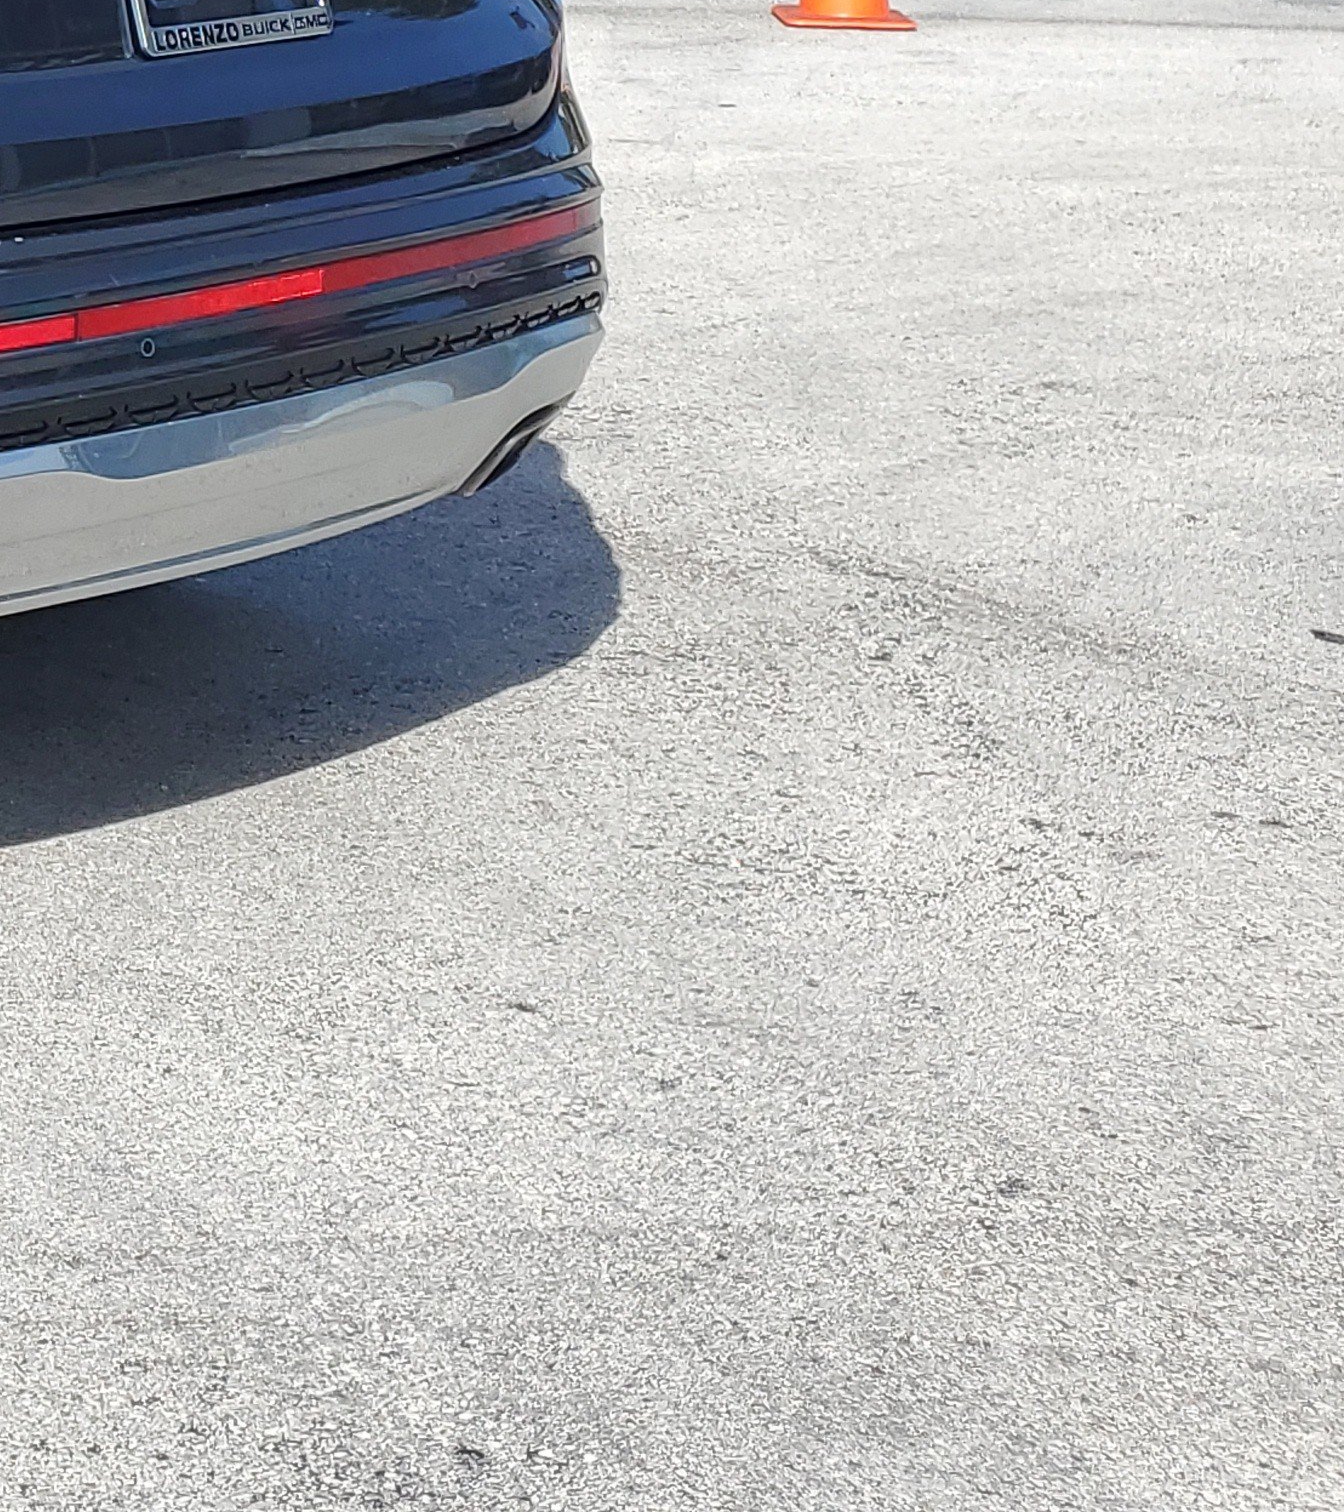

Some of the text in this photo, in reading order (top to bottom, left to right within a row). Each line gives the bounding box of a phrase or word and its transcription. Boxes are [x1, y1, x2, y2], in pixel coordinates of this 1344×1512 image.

[154, 13, 328, 52] LORENZO BUICK GMC
